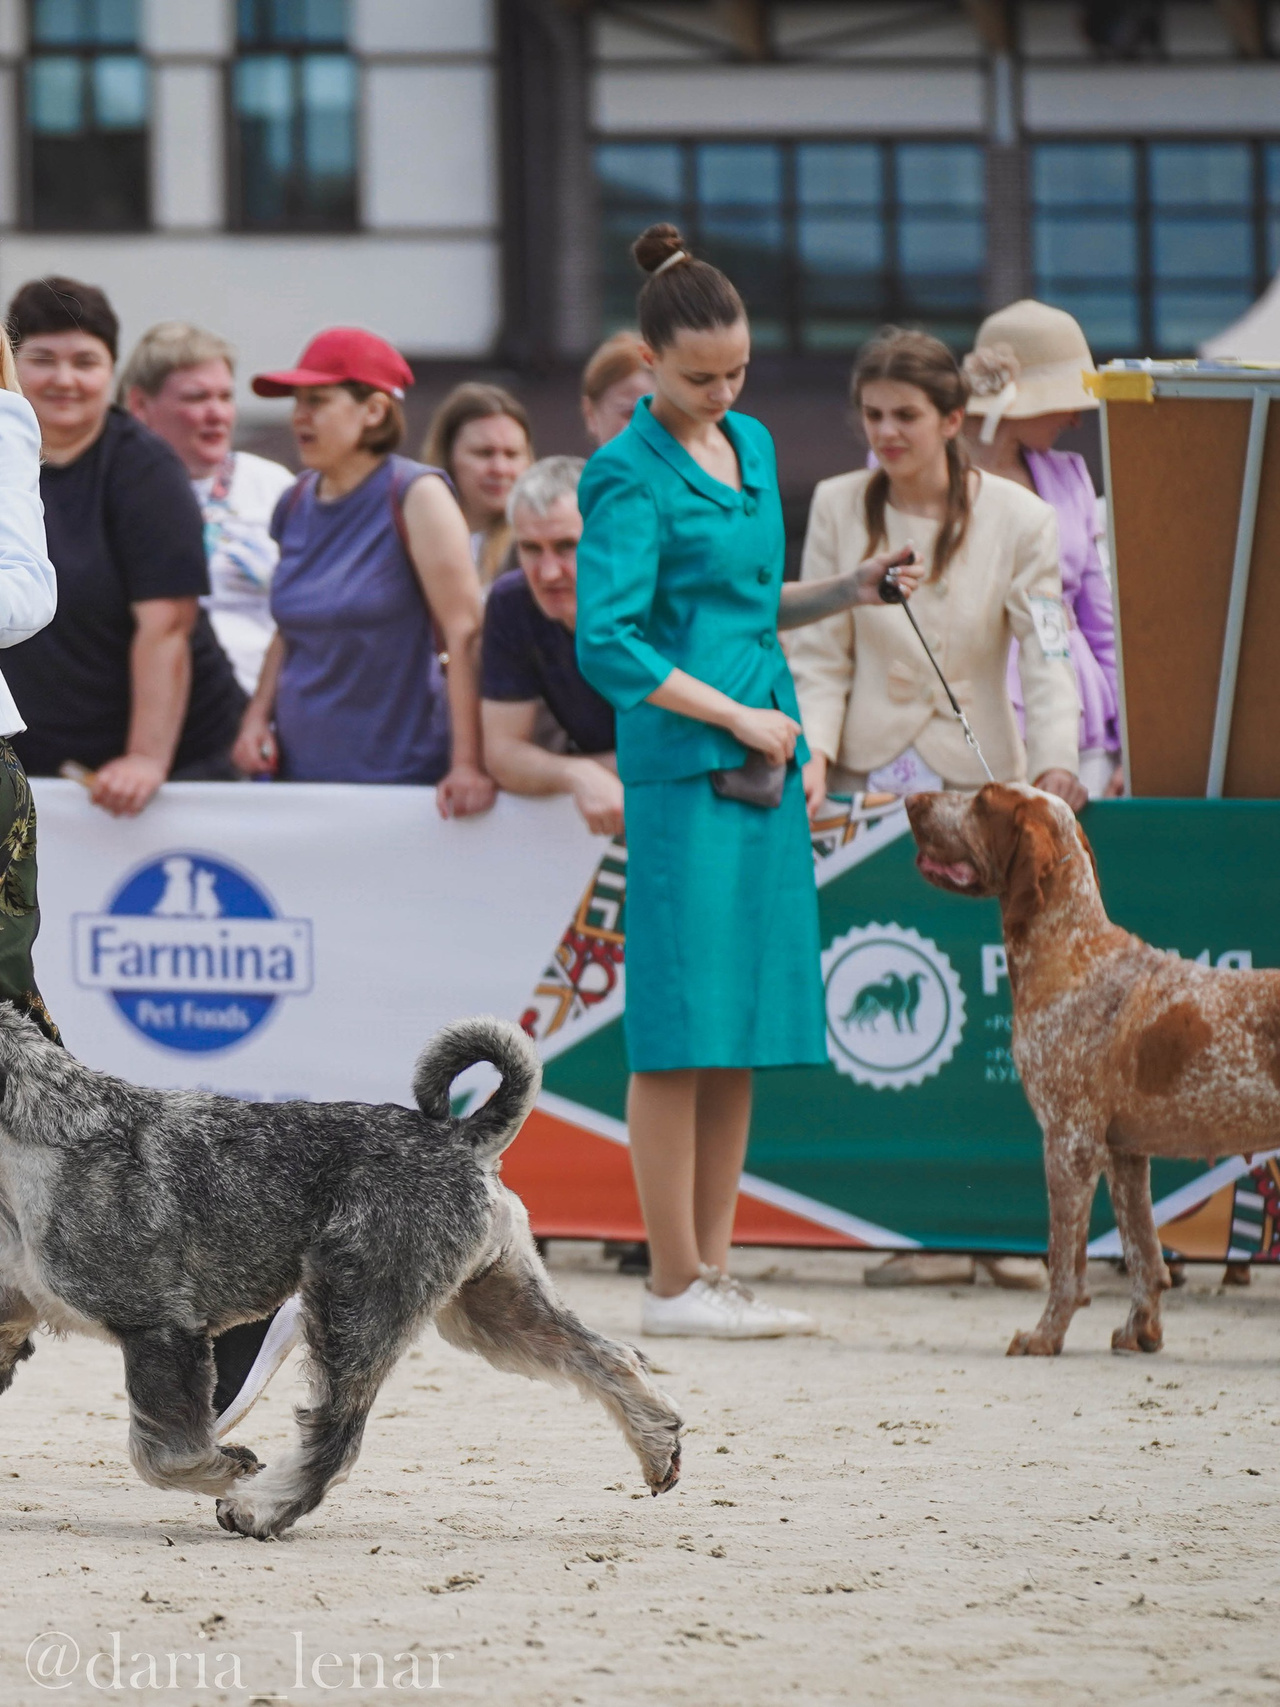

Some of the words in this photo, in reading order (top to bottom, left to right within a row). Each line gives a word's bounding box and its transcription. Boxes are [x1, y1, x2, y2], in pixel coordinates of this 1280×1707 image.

[88, 924, 296, 982] Farmina
[137, 998, 176, 1029] Pet
[180, 1001, 250, 1032] Foods
